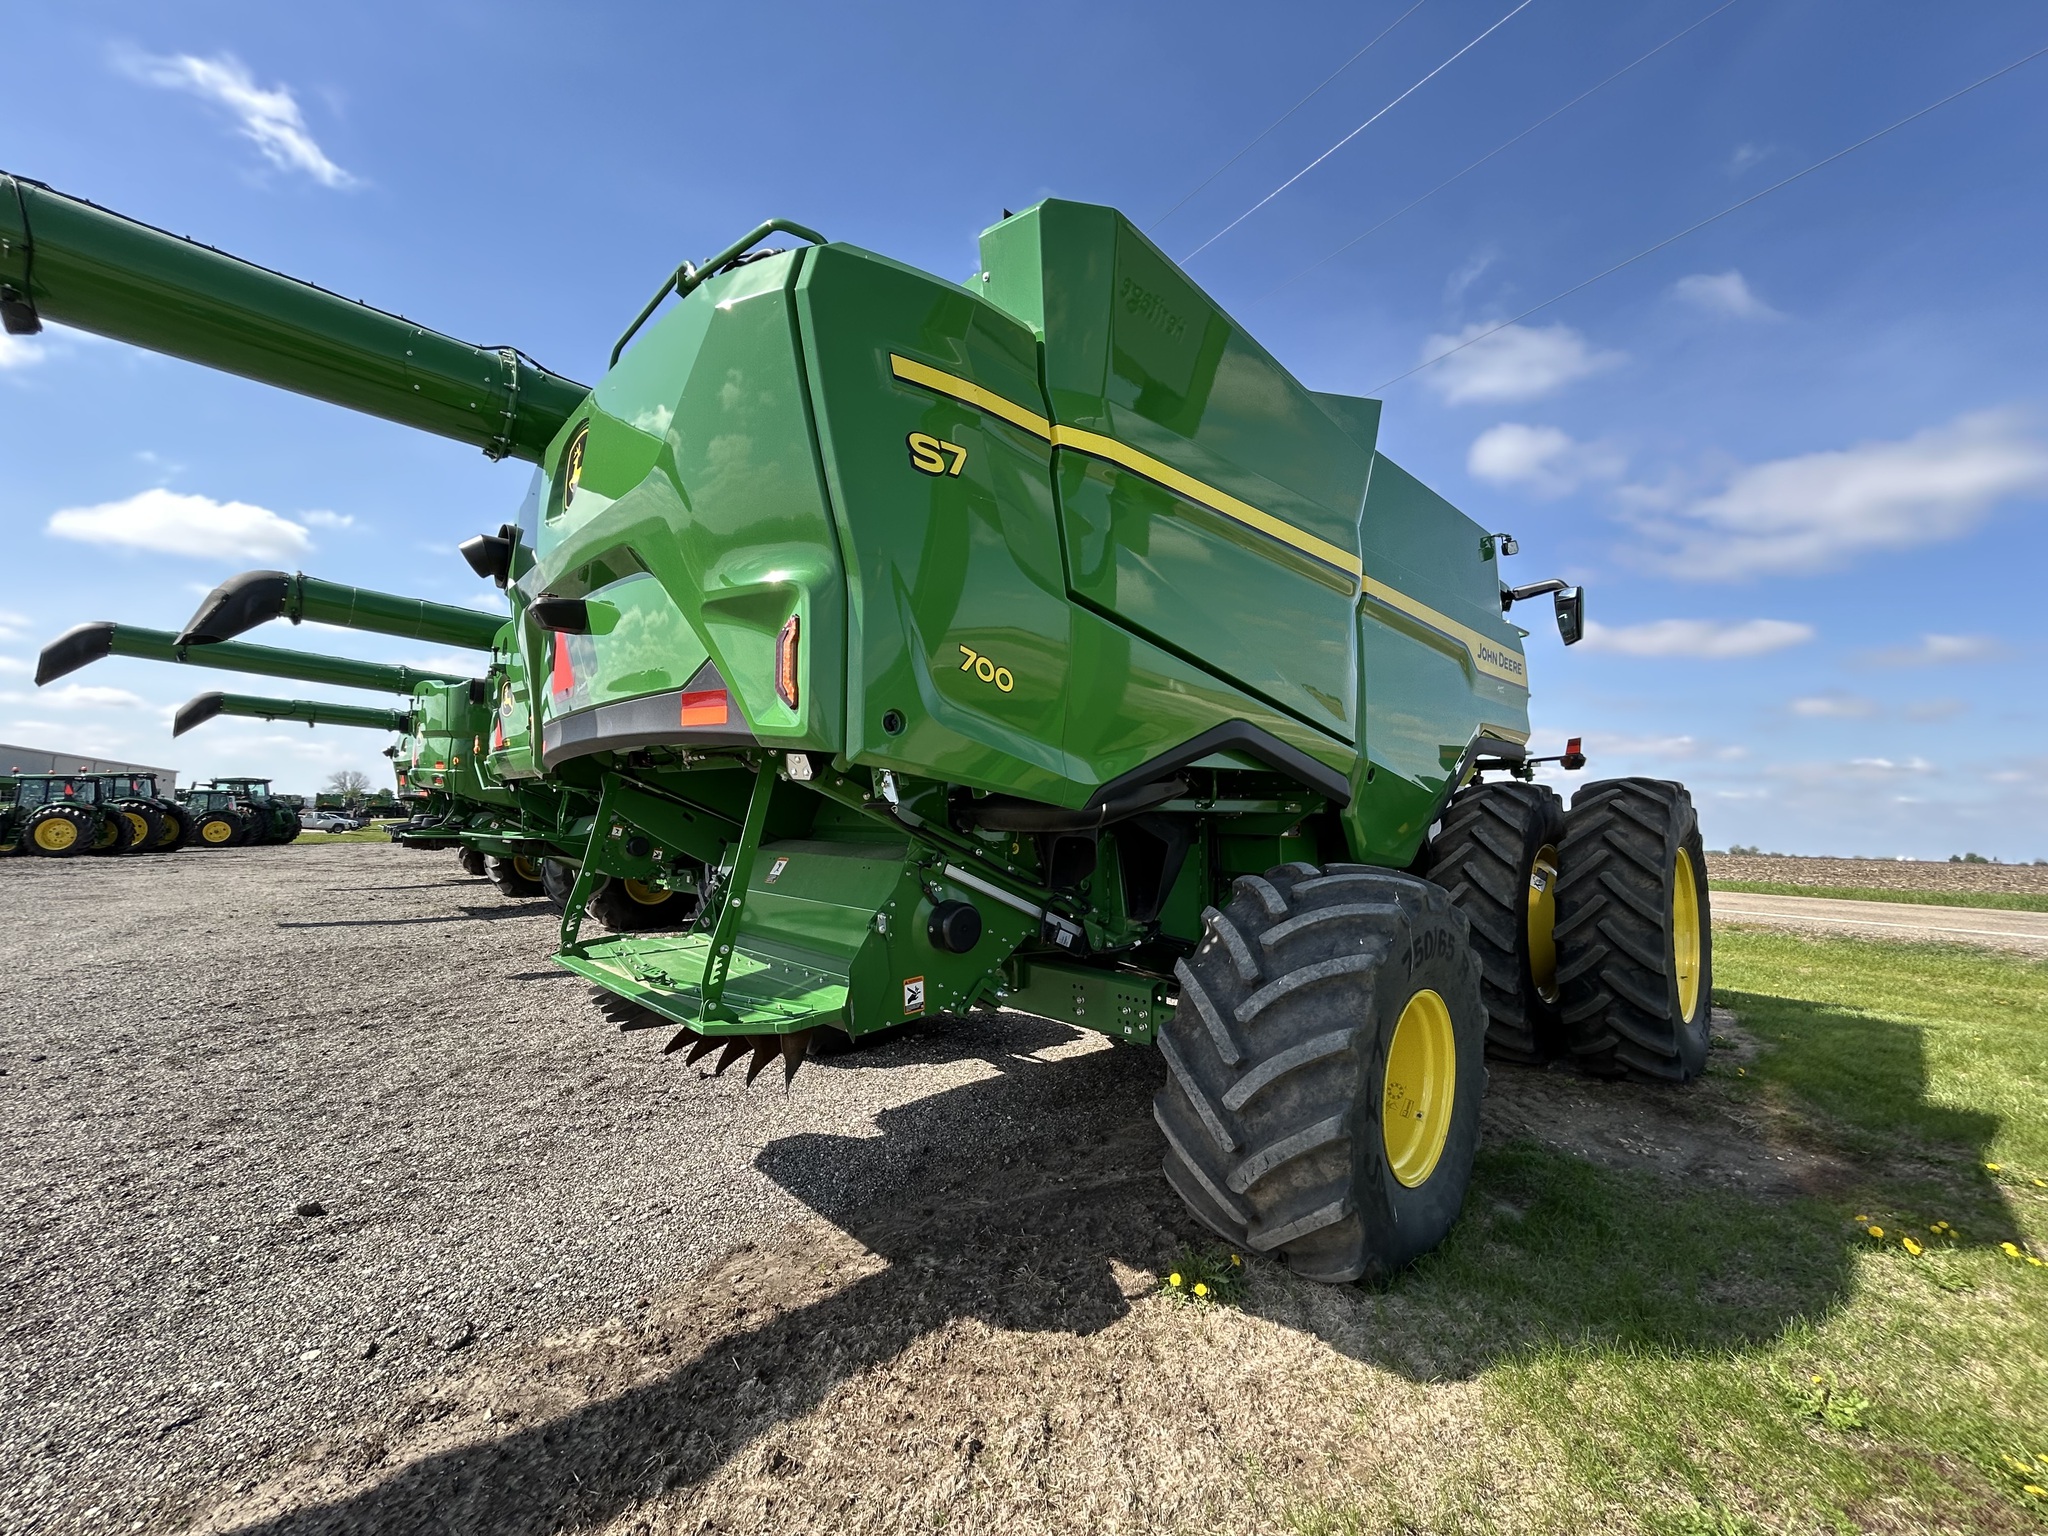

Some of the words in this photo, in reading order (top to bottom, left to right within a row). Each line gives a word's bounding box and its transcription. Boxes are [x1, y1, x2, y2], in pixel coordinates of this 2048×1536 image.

[906, 431, 968, 479] S7
[959, 643, 1015, 693] 700
[1477, 643, 1498, 666] JOHN
[1498, 651, 1522, 675] DEERE
[1401, 926, 1455, 981] 750/65
